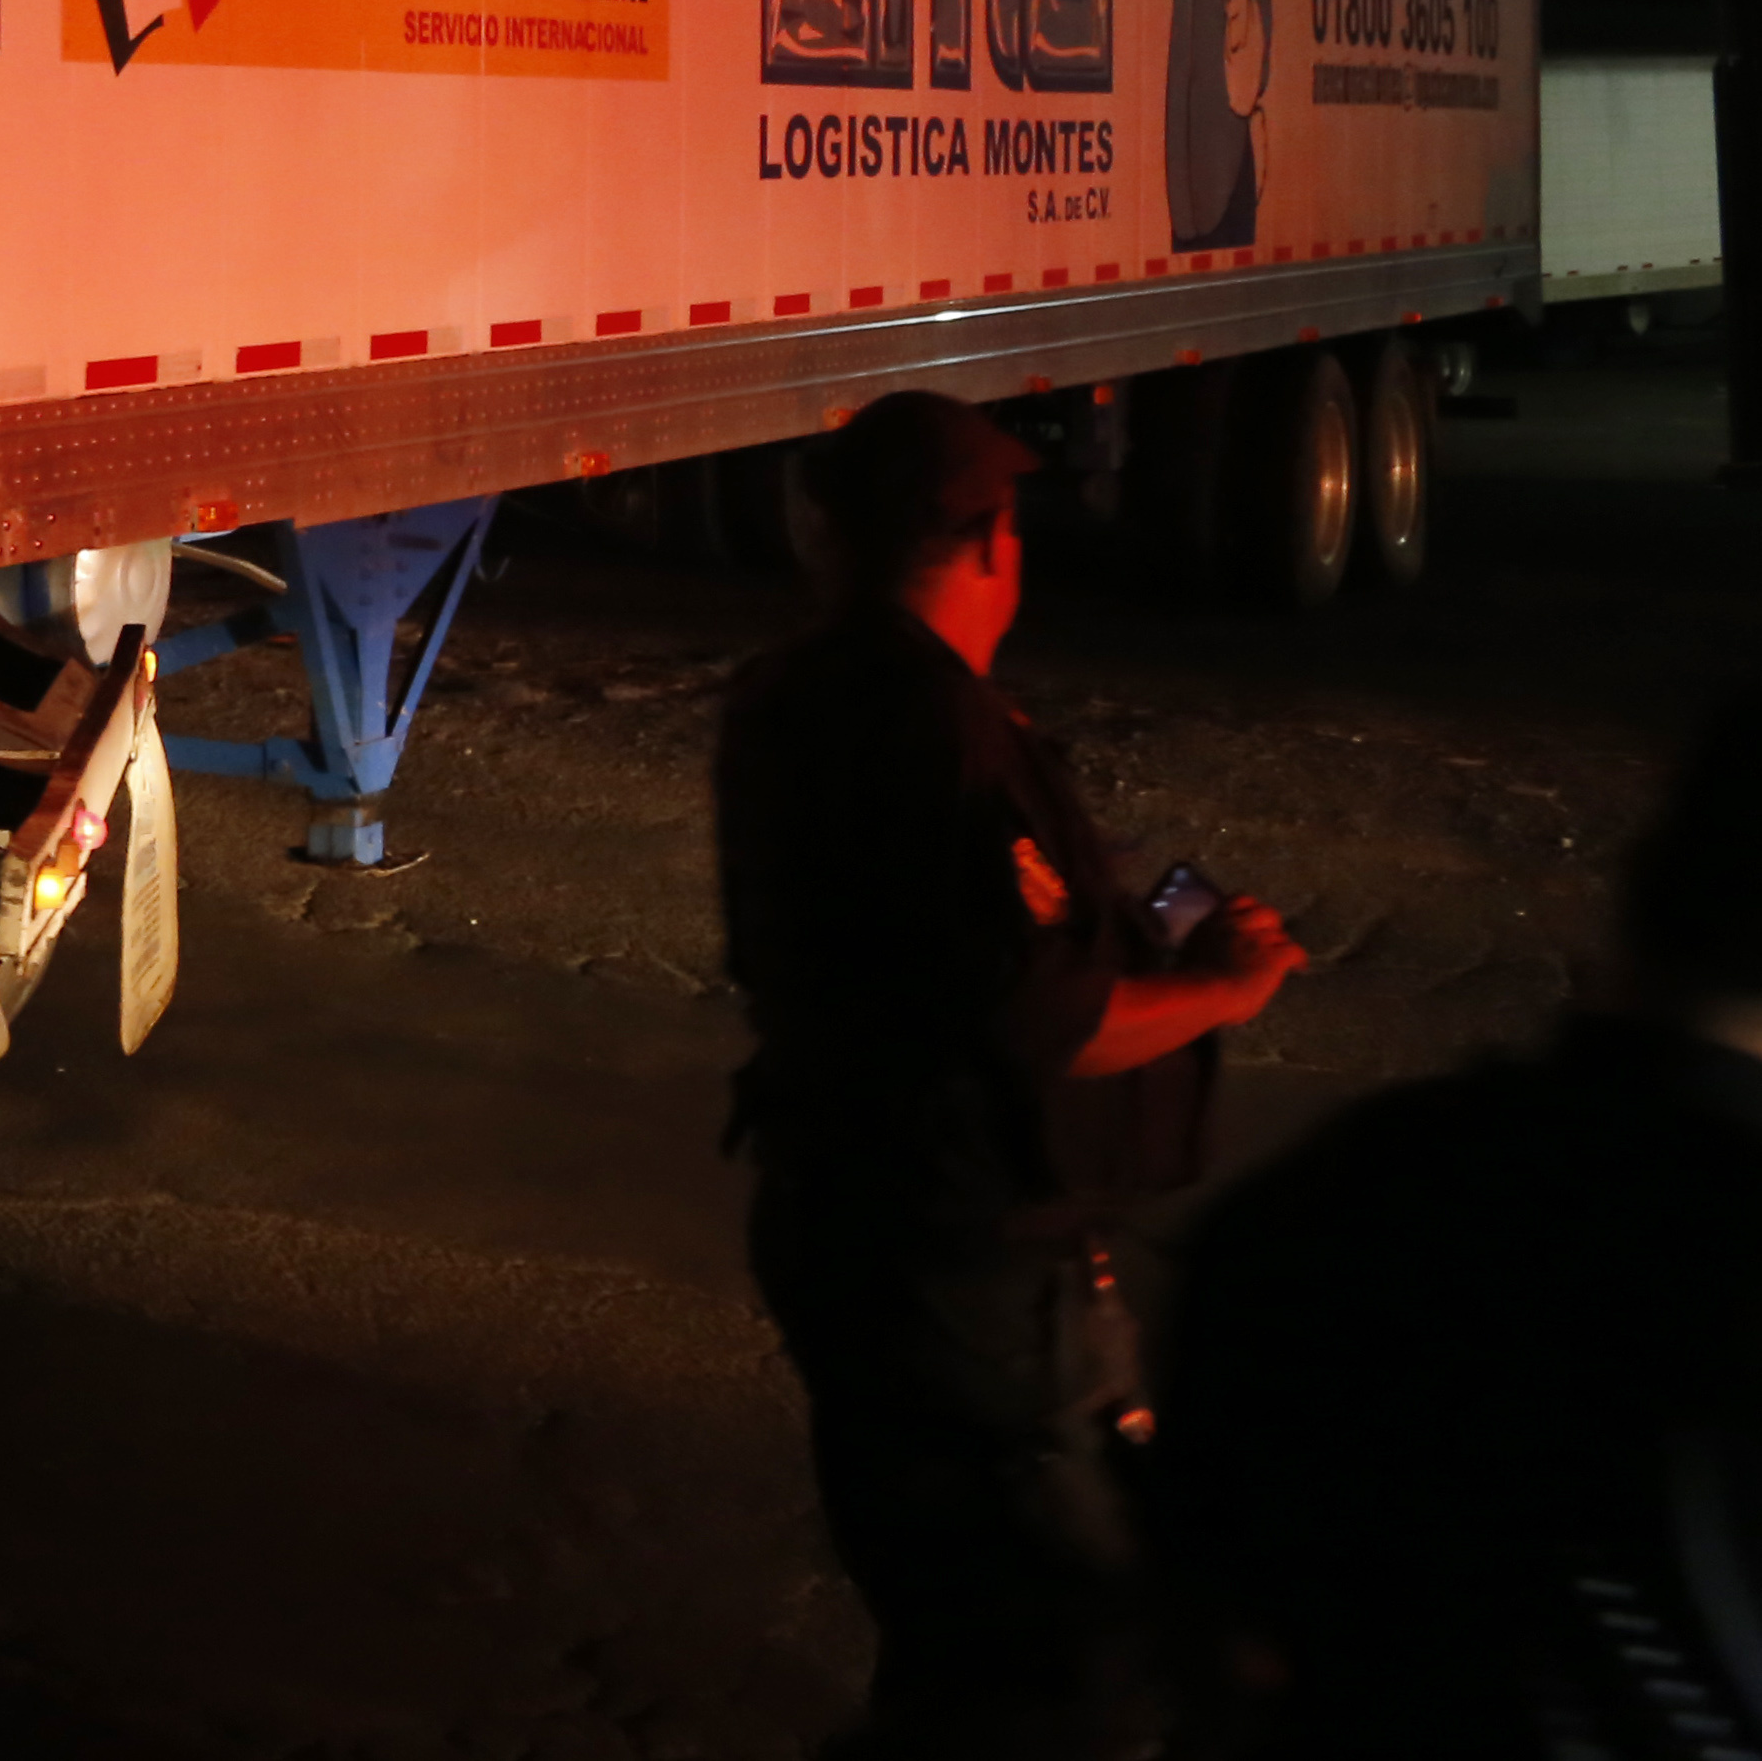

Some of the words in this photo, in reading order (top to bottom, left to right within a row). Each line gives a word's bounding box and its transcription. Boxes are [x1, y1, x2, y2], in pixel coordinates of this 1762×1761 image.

[403, 10, 499, 47] SERVICIO
[505, 16, 649, 56] INTERNACIONAL
[758, 113, 970, 180] LOGISTICA
[983, 118, 1114, 177] MONTES
